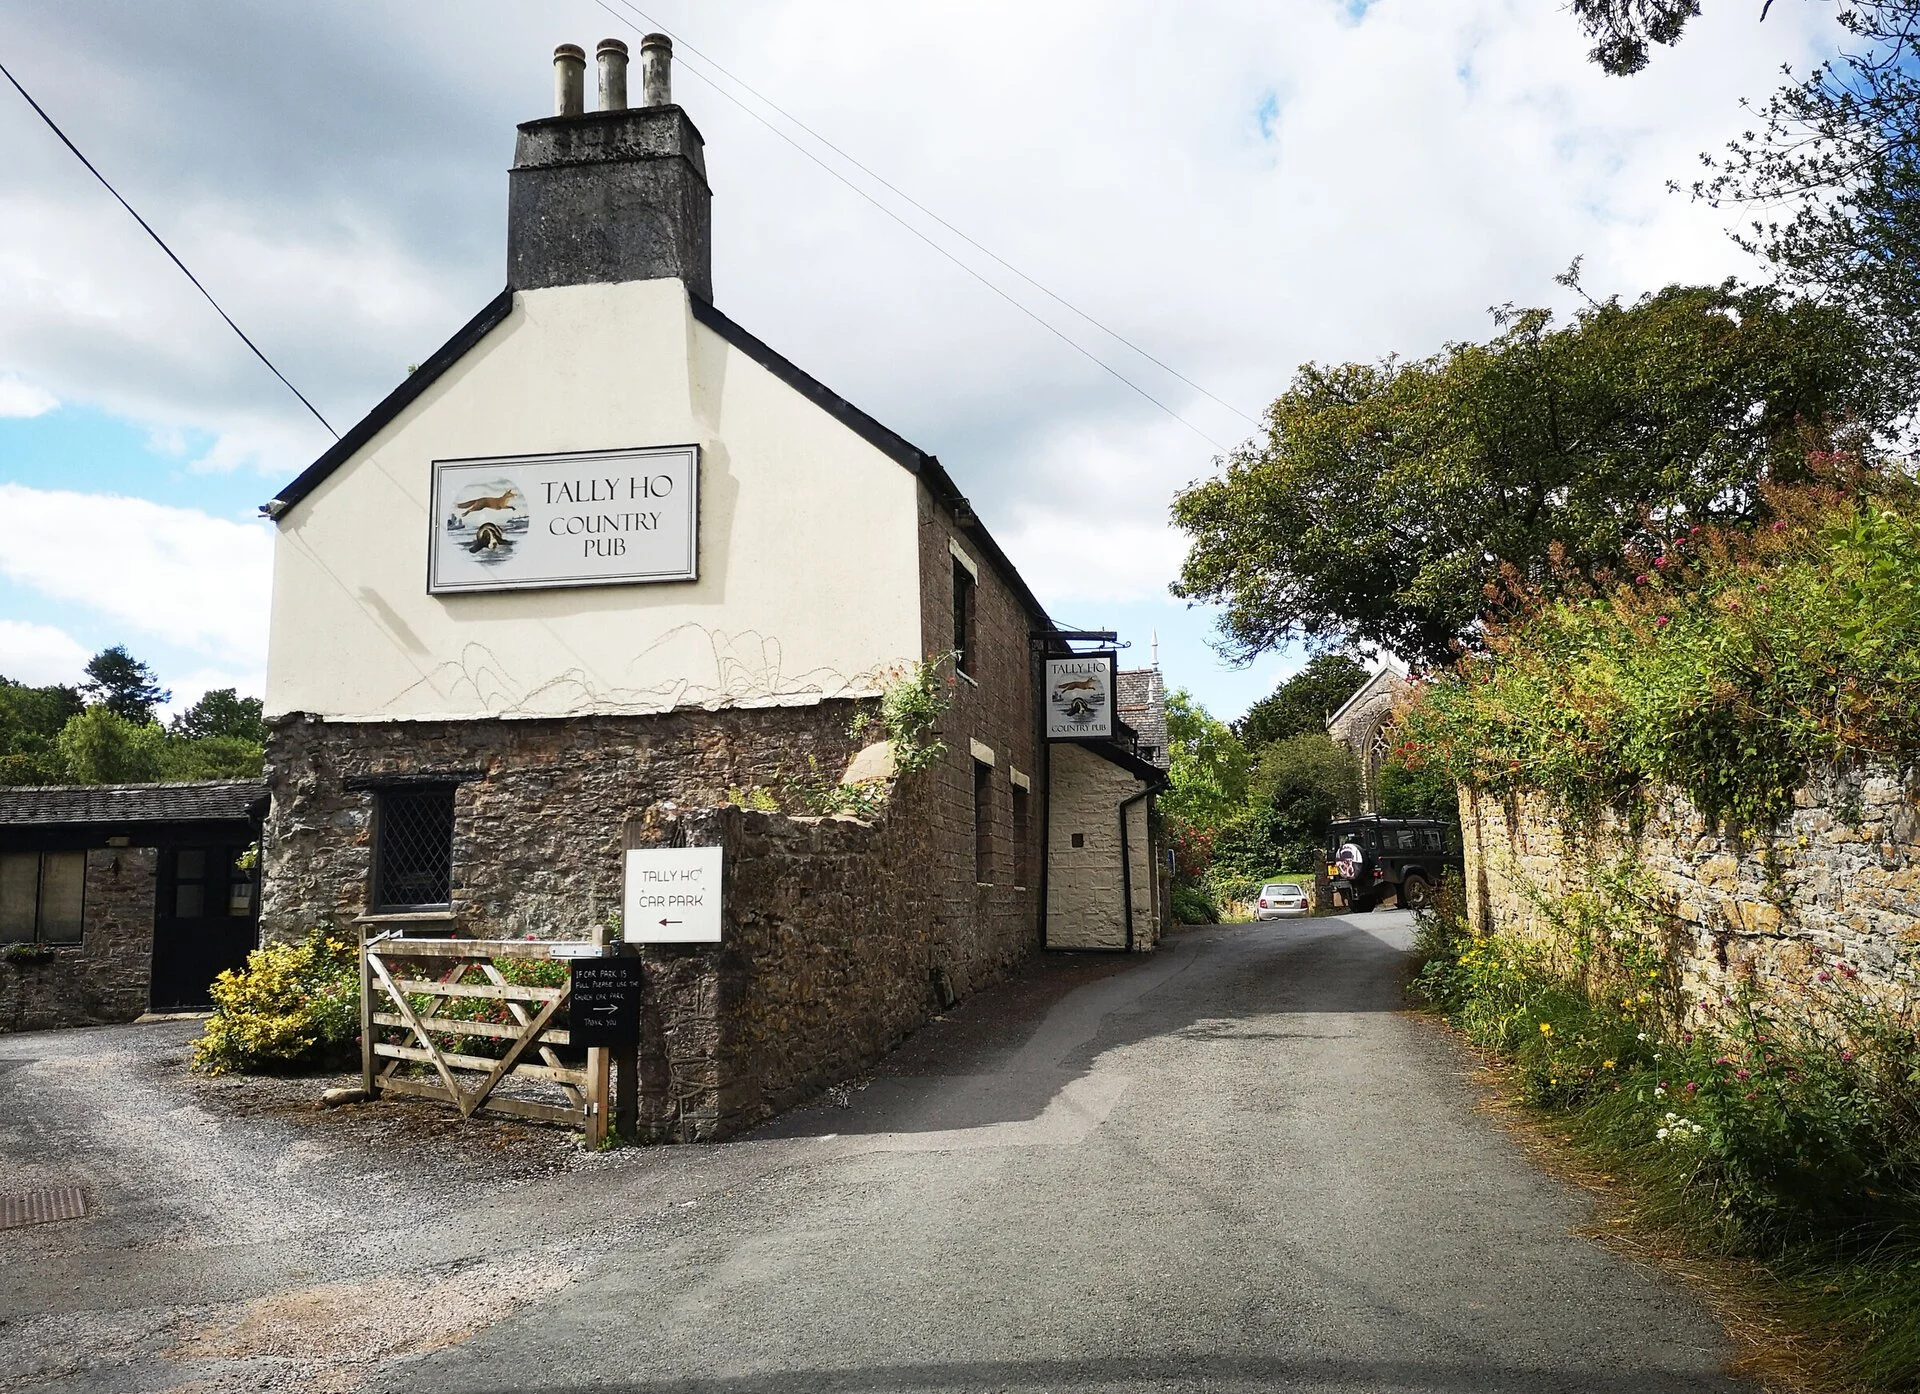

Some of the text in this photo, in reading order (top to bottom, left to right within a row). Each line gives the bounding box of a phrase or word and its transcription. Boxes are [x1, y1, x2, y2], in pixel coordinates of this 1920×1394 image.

[540, 474, 673, 504] TALLY HO
[548, 511, 662, 536] COUNTRY
[584, 537, 626, 557] PUB
[1051, 662, 1106, 674] TALLY HO
[1051, 723, 1106, 733] COUNTRY PUB
[642, 870, 678, 882] TALLY
[639, 895, 703, 908] CAR PARK
[575, 970, 627, 979] IF CAR PARK IS
[575, 981, 589, 989] FULL
[592, 980, 613, 988] PLEASE
[574, 992, 625, 1001] CHURCH CAR PARK
